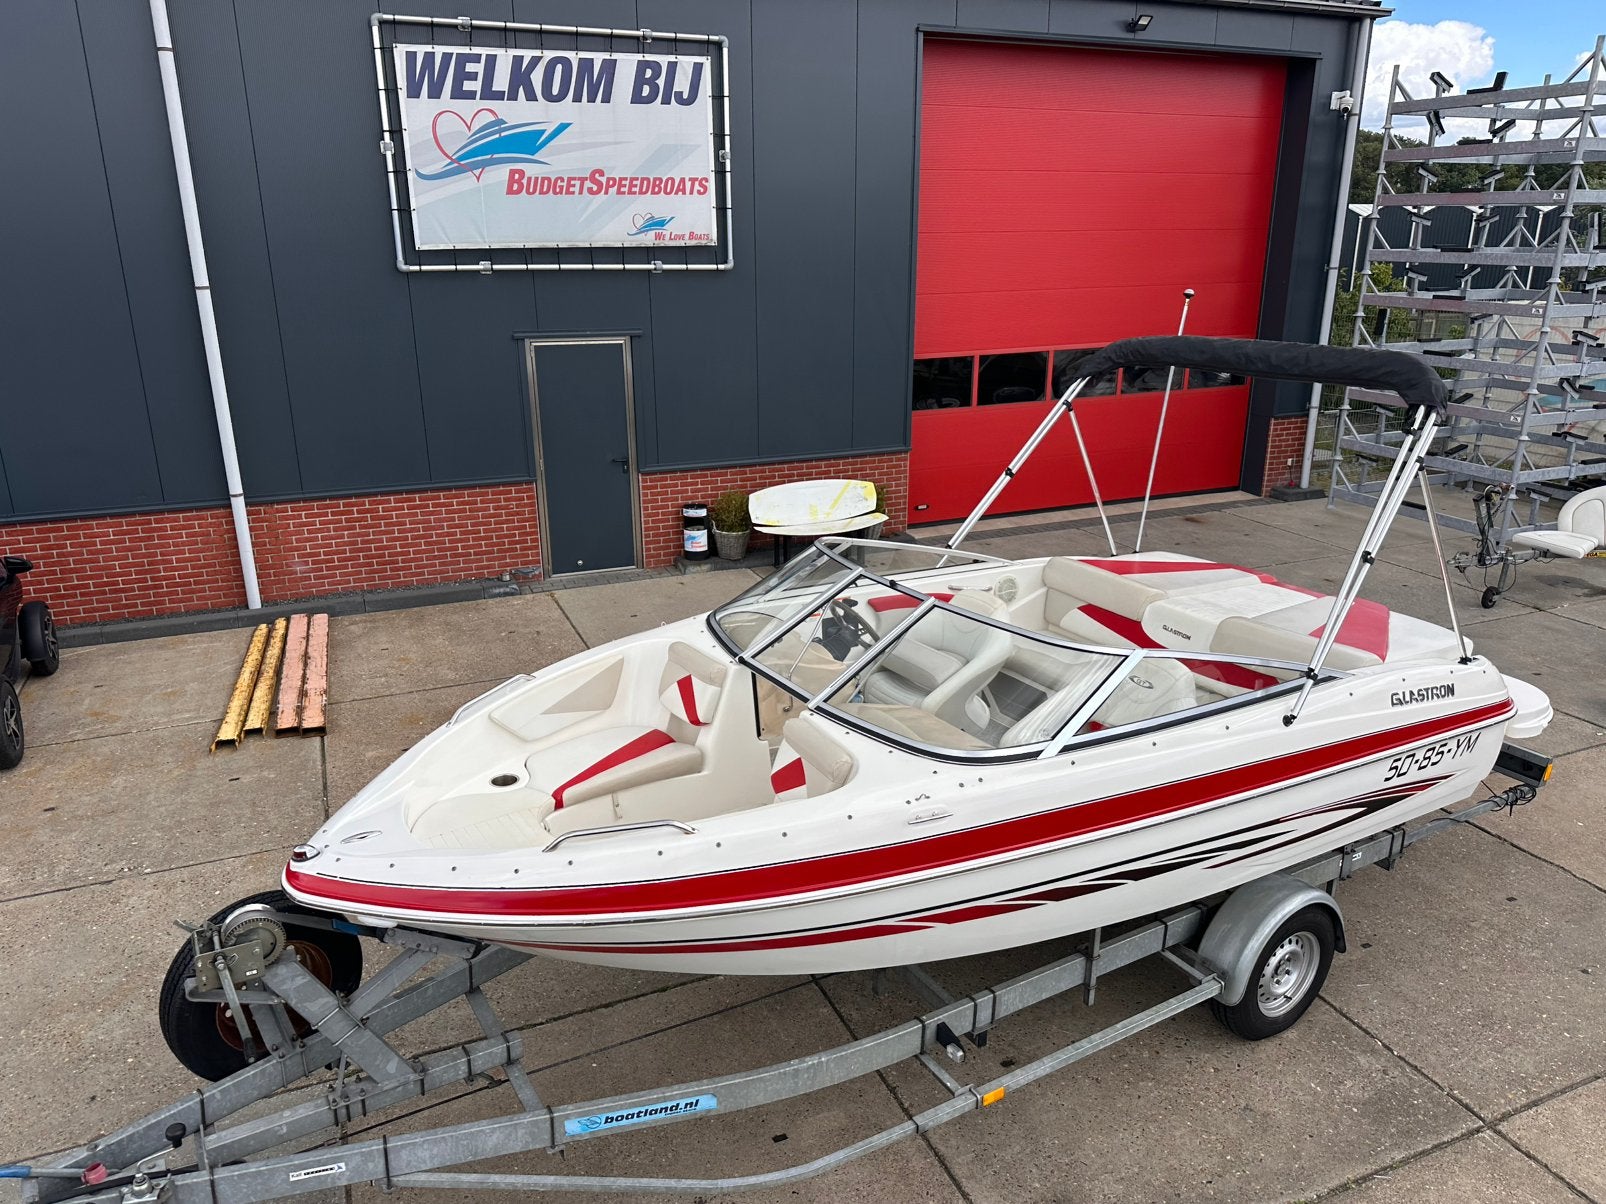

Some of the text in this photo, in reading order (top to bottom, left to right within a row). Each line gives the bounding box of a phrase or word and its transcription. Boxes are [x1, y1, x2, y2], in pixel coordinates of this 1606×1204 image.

[405, 50, 704, 107] WELKOM BIJ
[1162, 624, 1192, 641] GLASTRON
[1390, 683, 1455, 707] GLASTRON
[1384, 732, 1482, 782] 50-85-YM
[603, 1098, 700, 1125] boatland.nl
